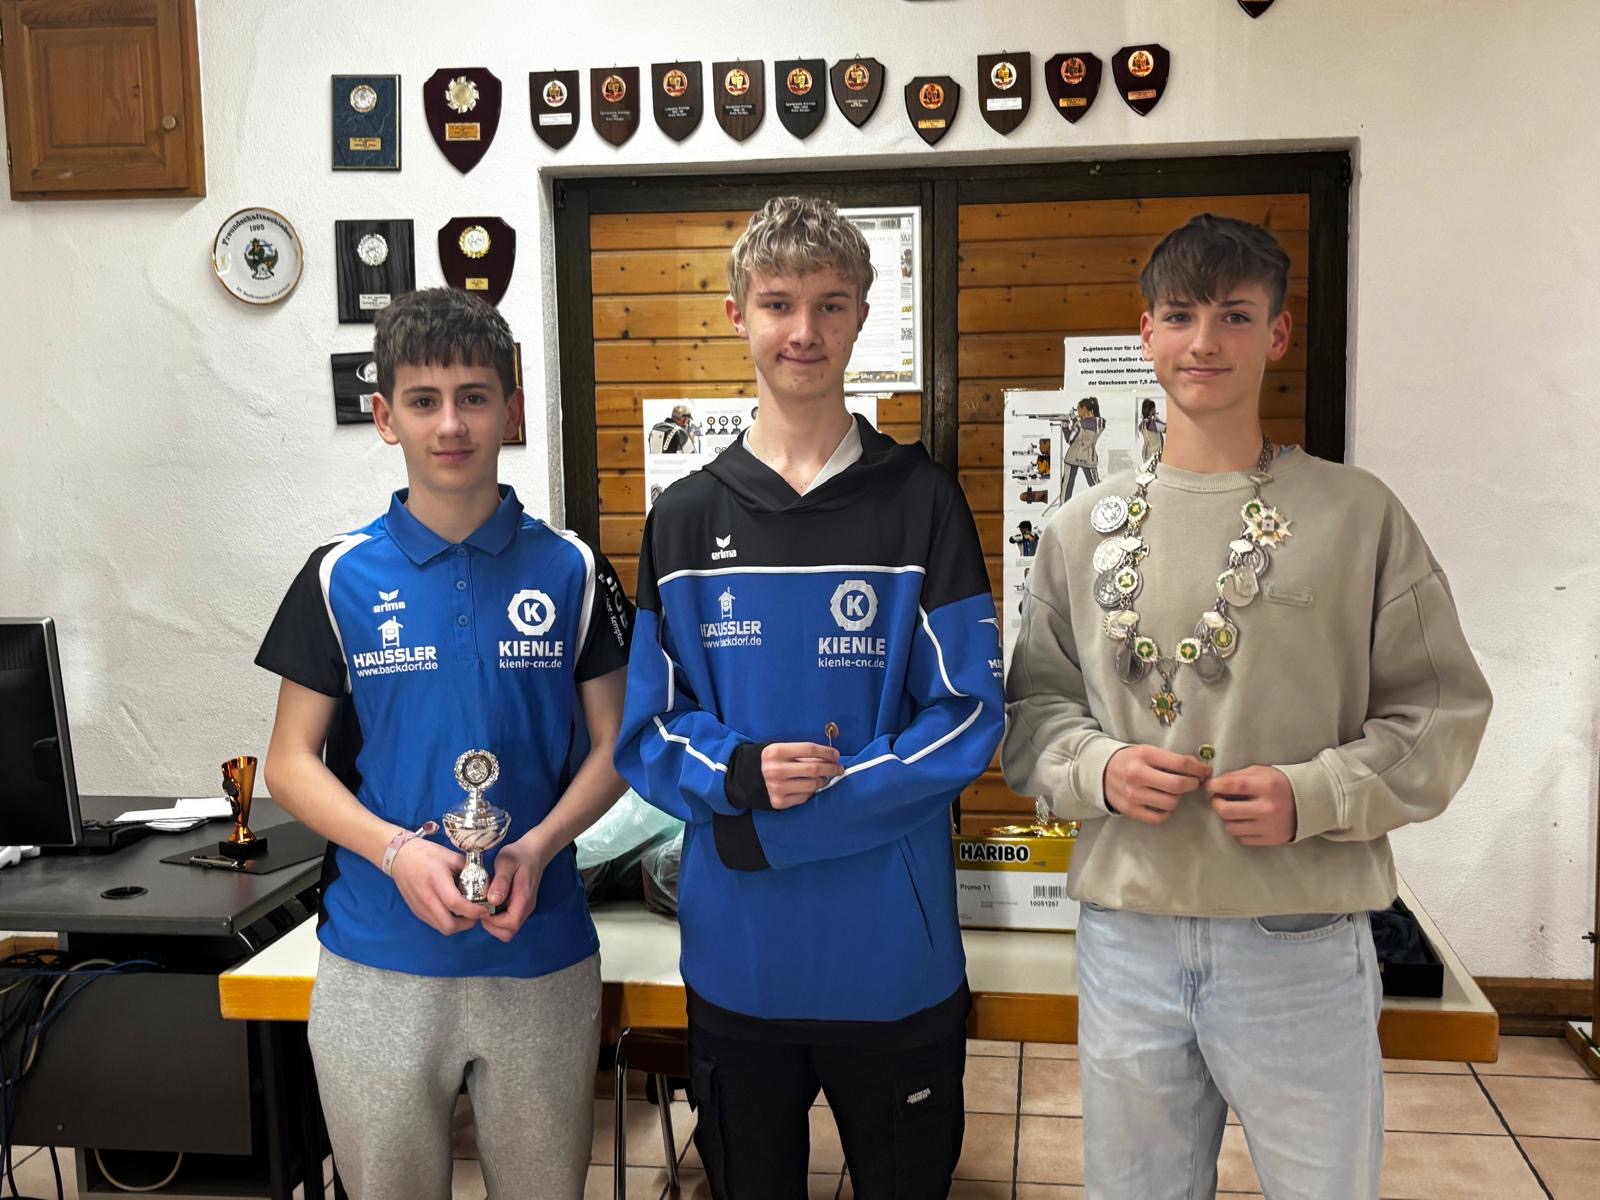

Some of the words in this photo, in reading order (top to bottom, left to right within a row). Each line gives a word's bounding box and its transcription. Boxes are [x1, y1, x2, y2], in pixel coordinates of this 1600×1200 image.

[711, 549, 737, 560] erima
[373, 601, 406, 613] erima
[498, 640, 564, 657] KIENLE
[818, 636, 886, 656] KIENLE
[353, 646, 437, 668] HÄUSSLER
[499, 658, 562, 669] kienle-cnc.de
[818, 656, 885, 669] kienle-cnc.de
[356, 660, 438, 678] www.backdorf.de
[960, 843, 1029, 862] HARIBO
